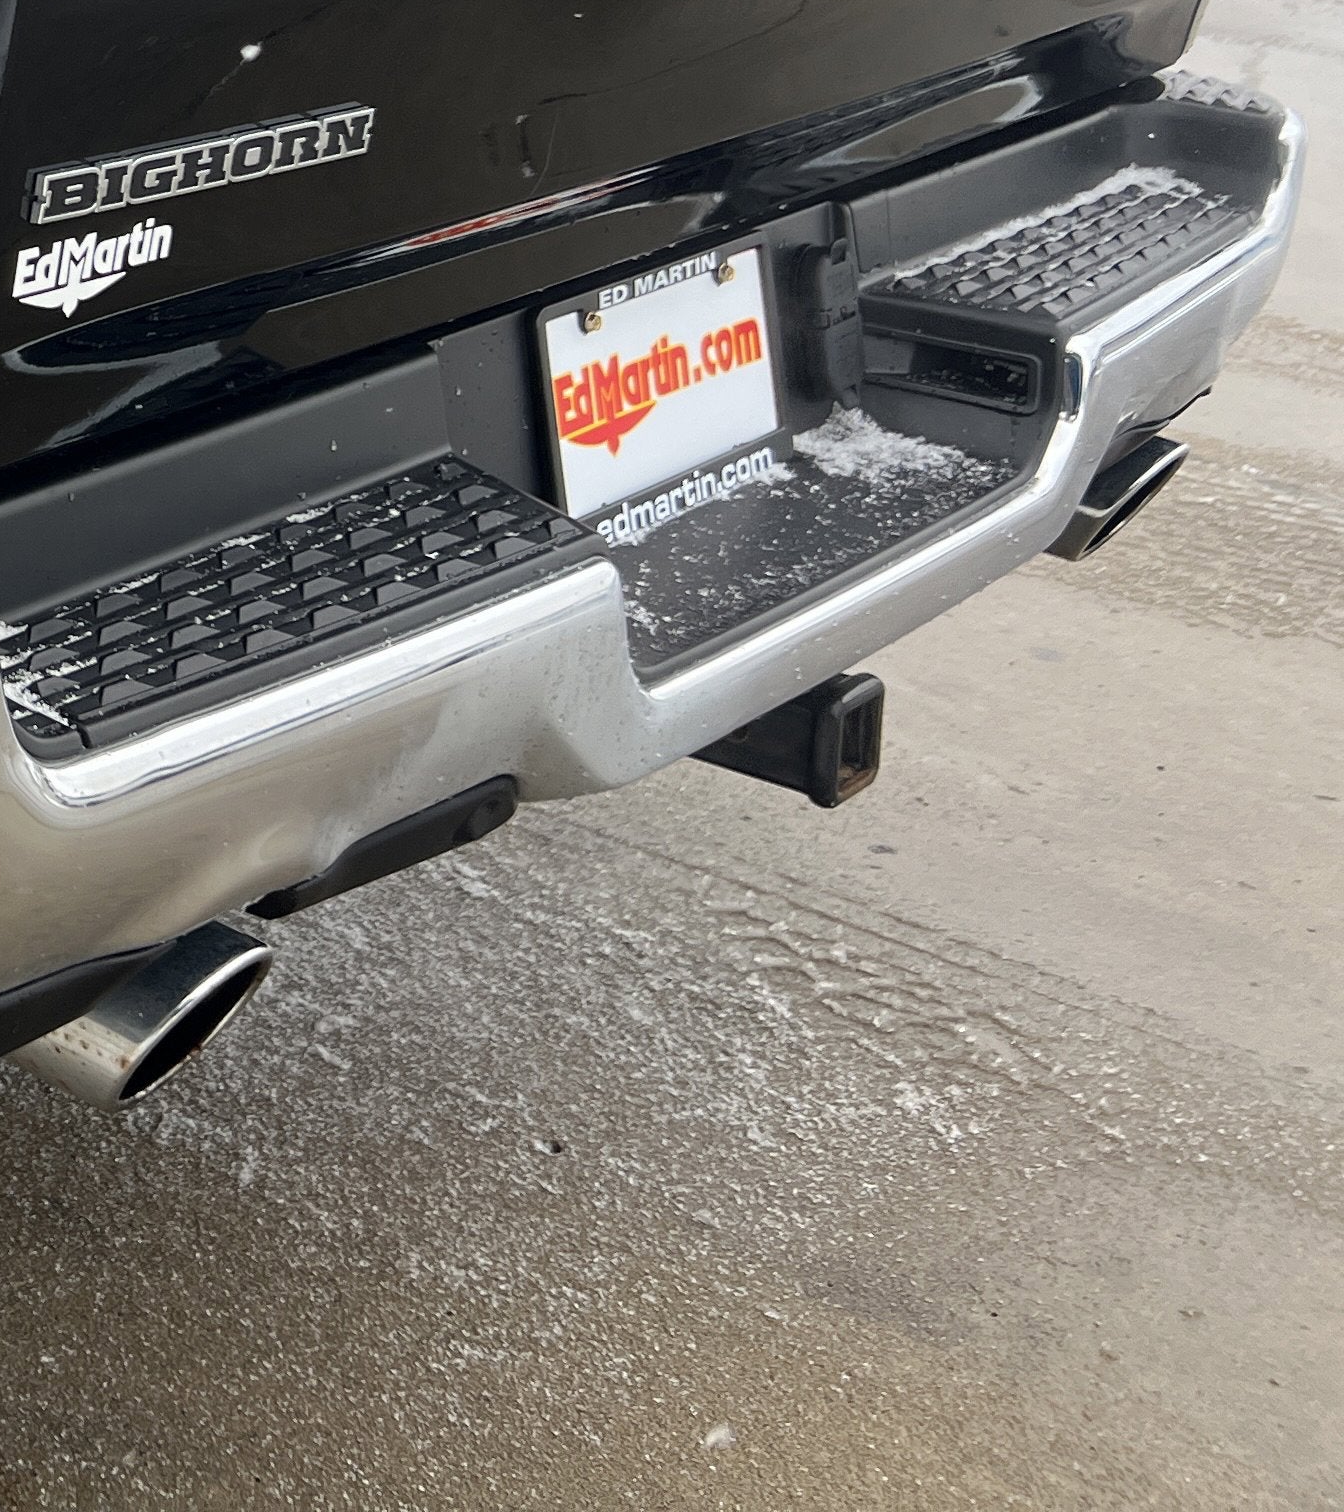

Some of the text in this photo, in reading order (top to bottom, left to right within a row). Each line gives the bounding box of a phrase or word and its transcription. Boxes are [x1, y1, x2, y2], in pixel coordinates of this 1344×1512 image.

[598, 251, 717, 309] ED MARTIN
[553, 317, 762, 438] EdMartin.com
[596, 446, 773, 546] edmartin.com
